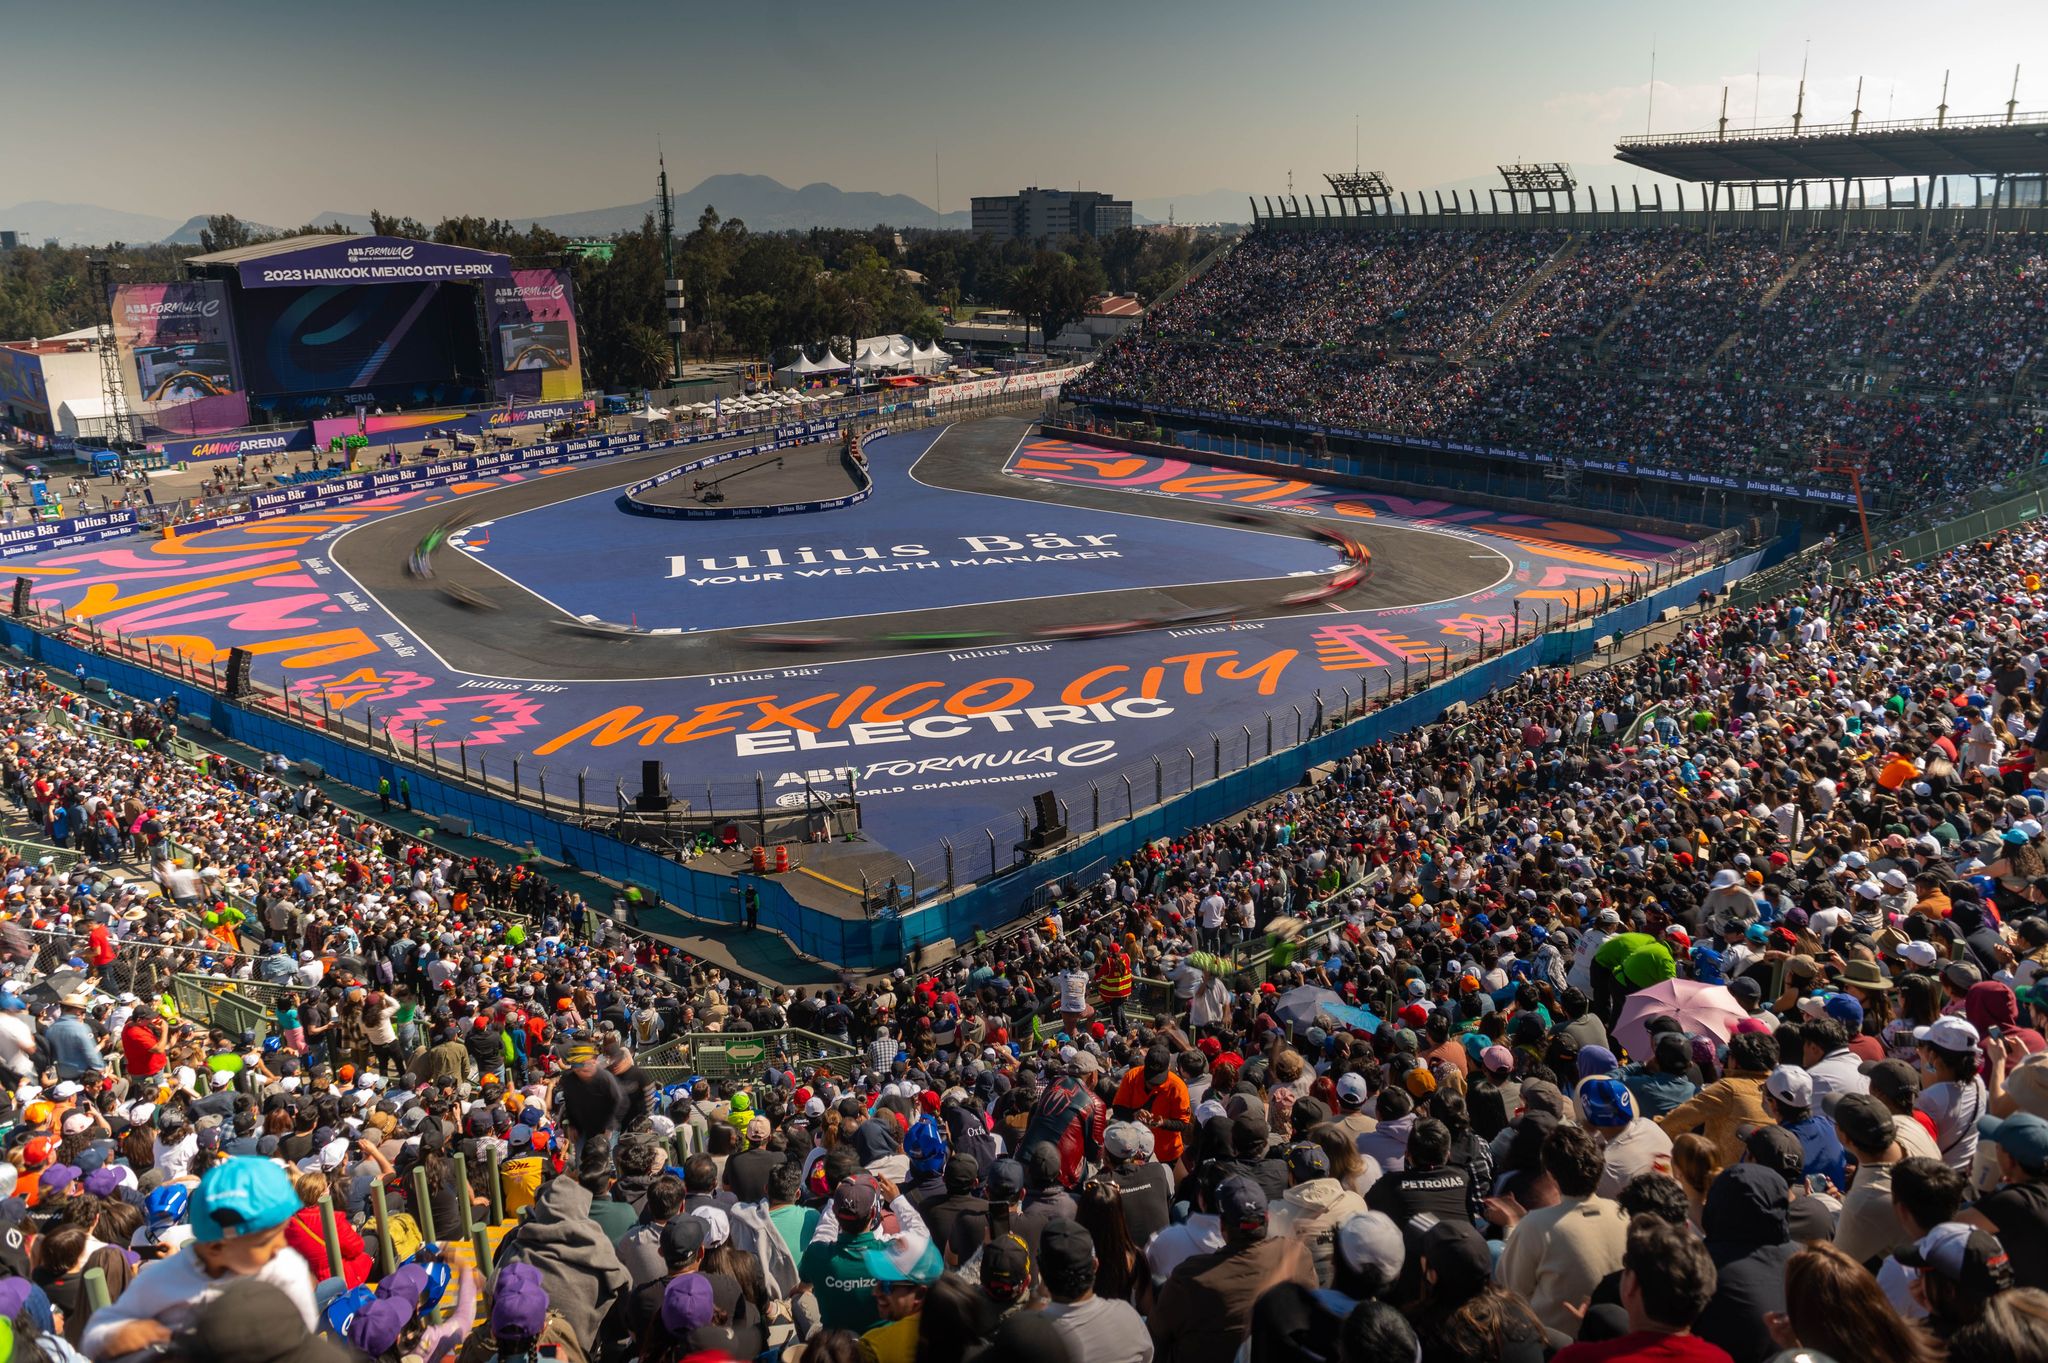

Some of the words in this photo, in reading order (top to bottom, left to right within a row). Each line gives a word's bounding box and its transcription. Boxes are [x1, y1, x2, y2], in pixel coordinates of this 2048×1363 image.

[348, 248, 364, 256] ABB
[364, 247, 401, 256] FORMULA
[263, 270, 302, 281] 2023
[303, 267, 370, 280] HANKOOK
[371, 266, 422, 277] MEXICO
[425, 265, 452, 276] CITY
[454, 264, 493, 274] E-PRIX
[495, 288, 512, 296] ABB
[513, 286, 552, 296] FORMULA
[125, 304, 148, 314] ABB
[149, 301, 202, 314] FORMULA
[938, 387, 953, 396] BOSCH
[961, 384, 975, 392] BOSCH
[344, 393, 375, 403] RENA
[527, 408, 564, 420] ARENA
[778, 430, 794, 439] Julus
[795, 427, 804, 435] Bär
[810, 423, 825, 432] Julius
[566, 442, 587, 452] Julius
[588, 440, 601, 448] Bär
[608, 437, 627, 446] Julius
[628, 434, 640, 442] Bär
[192, 441, 240, 457] GAMING
[240, 437, 287, 451] ARENA
[522, 450, 544, 460] Julius
[546, 446, 559, 454] Bär
[1489, 447, 1505, 456] Julius
[476, 458, 498, 468] Julius
[500, 453, 514, 462] Bär
[1584, 459, 1603, 469] Julius
[1604, 462, 1616, 470] Bär
[426, 466, 451, 477] Julius
[452, 462, 468, 470] Bär
[1636, 466, 1656, 476] Julius
[1656, 469, 1669, 477] Bär
[373, 474, 399, 486] Julius
[400, 470, 417, 480] Bär
[1688, 473, 1709, 483] Julius
[1710, 476, 1723, 484] Bär
[317, 484, 344, 497] Julius
[347, 479, 364, 490] Bär
[1747, 481, 1769, 491] Julius
[1770, 484, 1784, 493] Bär
[256, 495, 286, 508] Julius
[288, 490, 306, 500] Bär
[1806, 488, 1829, 499] Julius
[1830, 492, 1845, 500] Bär
[300, 503, 315, 511] Julius
[820, 502, 834, 510] Julius
[259, 510, 275, 518] Julius
[74, 516, 107, 532] Julius
[110, 512, 131, 523] Bär
[216, 518, 234, 526] Julius
[0, 530, 35, 544] Julius
[101, 531, 119, 539] Julius
[53, 538, 73, 547] Julius
[3, 547, 24, 556] Julius
[664, 542, 931, 579] Julius
[957, 532, 1118, 553] Bär
[688, 571, 784, 586] YOUR
[793, 560, 941, 578] WEALTH
[950, 549, 1124, 567] MANAGER
[1168, 625, 1228, 638] Julius
[1229, 620, 1266, 631] Bär
[947, 650, 1010, 663] Julius
[1015, 642, 1054, 655] Bär
[708, 672, 776, 687] Julius
[784, 667, 824, 678] Bär
[457, 678, 523, 695] Julius
[525, 682, 569, 694] Bär
[532, 677, 1035, 755] MEXICO
[1060, 649, 1299, 706] CITY
[735, 697, 1175, 757] ELECTRIC
[773, 766, 858, 787] ABB
[863, 746, 1053, 780] FORMULA
[833, 785, 905, 799] WORLD
[912, 771, 1059, 791] CHAMPIONSHIP
[1402, 1177, 1464, 1189] PETRONAS
